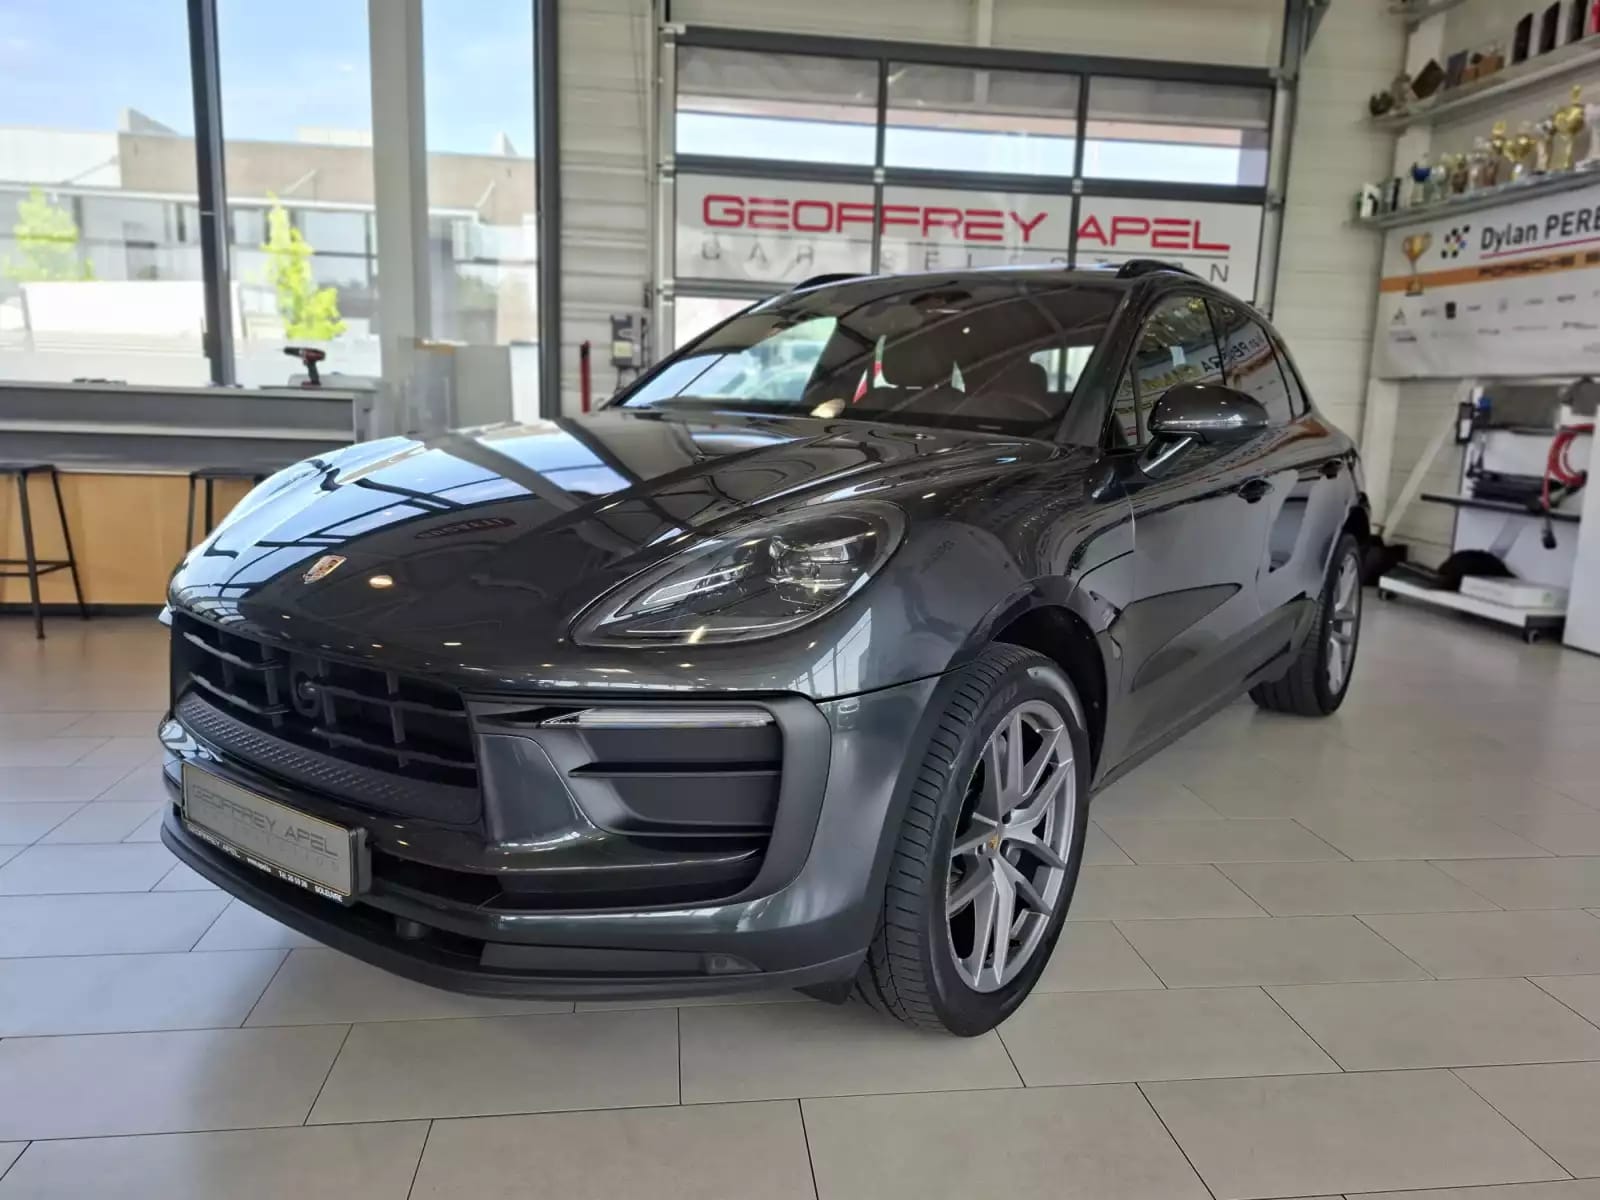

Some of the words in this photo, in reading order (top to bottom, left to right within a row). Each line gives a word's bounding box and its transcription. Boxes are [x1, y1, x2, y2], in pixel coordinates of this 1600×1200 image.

[702, 195, 1048, 242] GEOFFREY
[1076, 214, 1230, 251] APEL
[1480, 223, 1538, 253] Dylan
[284, 825, 339, 857] APEL
